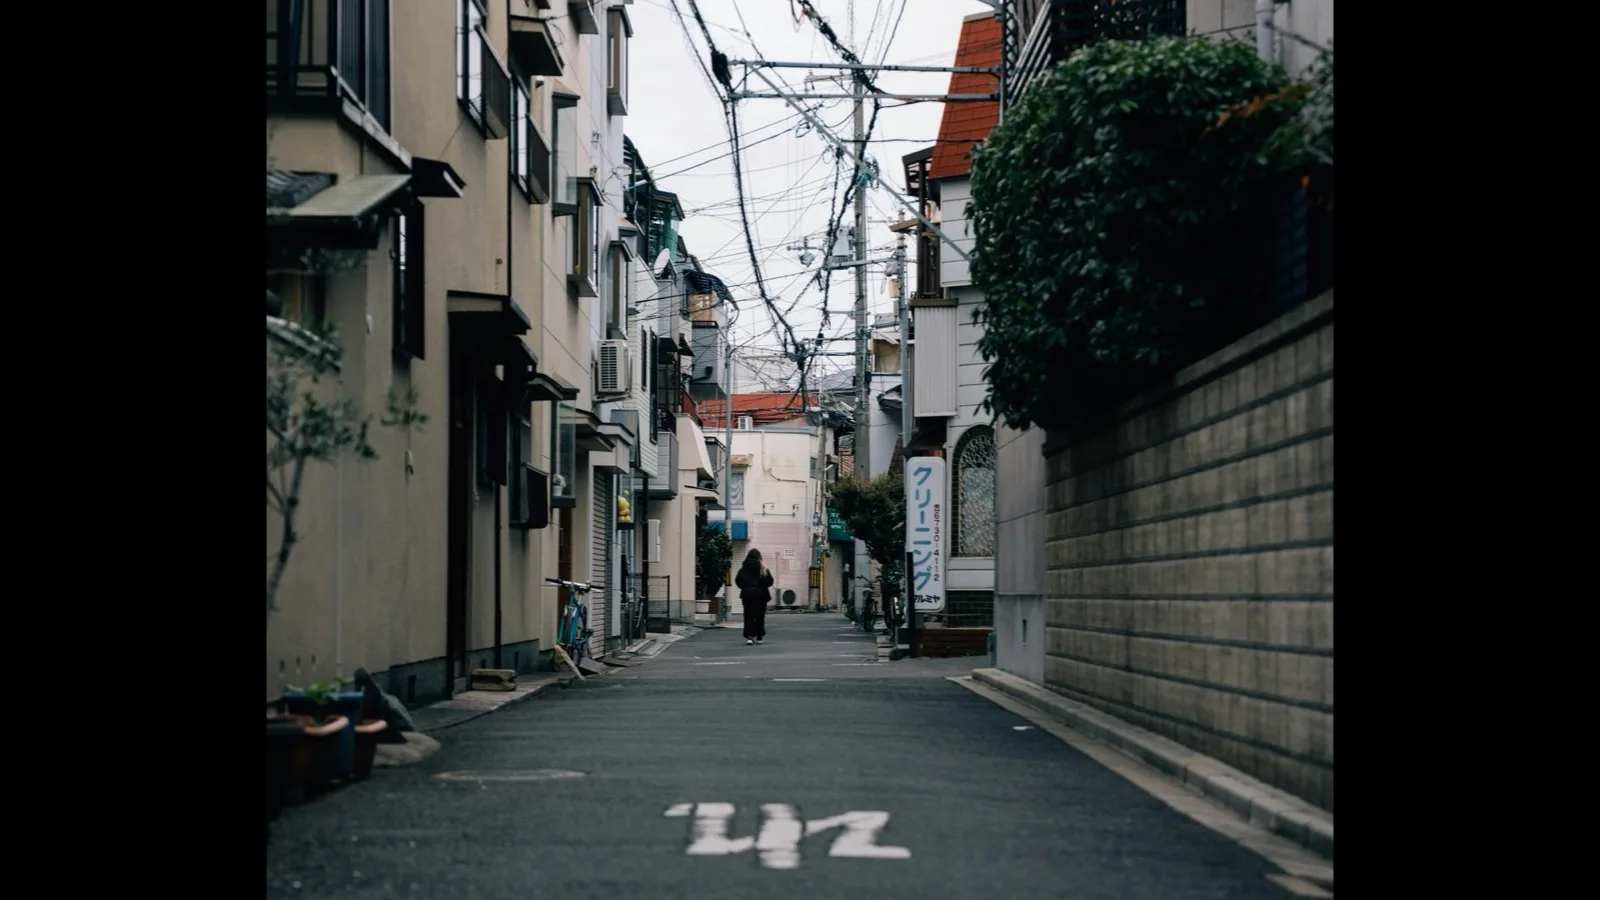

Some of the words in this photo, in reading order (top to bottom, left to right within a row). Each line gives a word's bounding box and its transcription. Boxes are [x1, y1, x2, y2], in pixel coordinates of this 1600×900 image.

[912, 466, 932, 591] クリーニング
